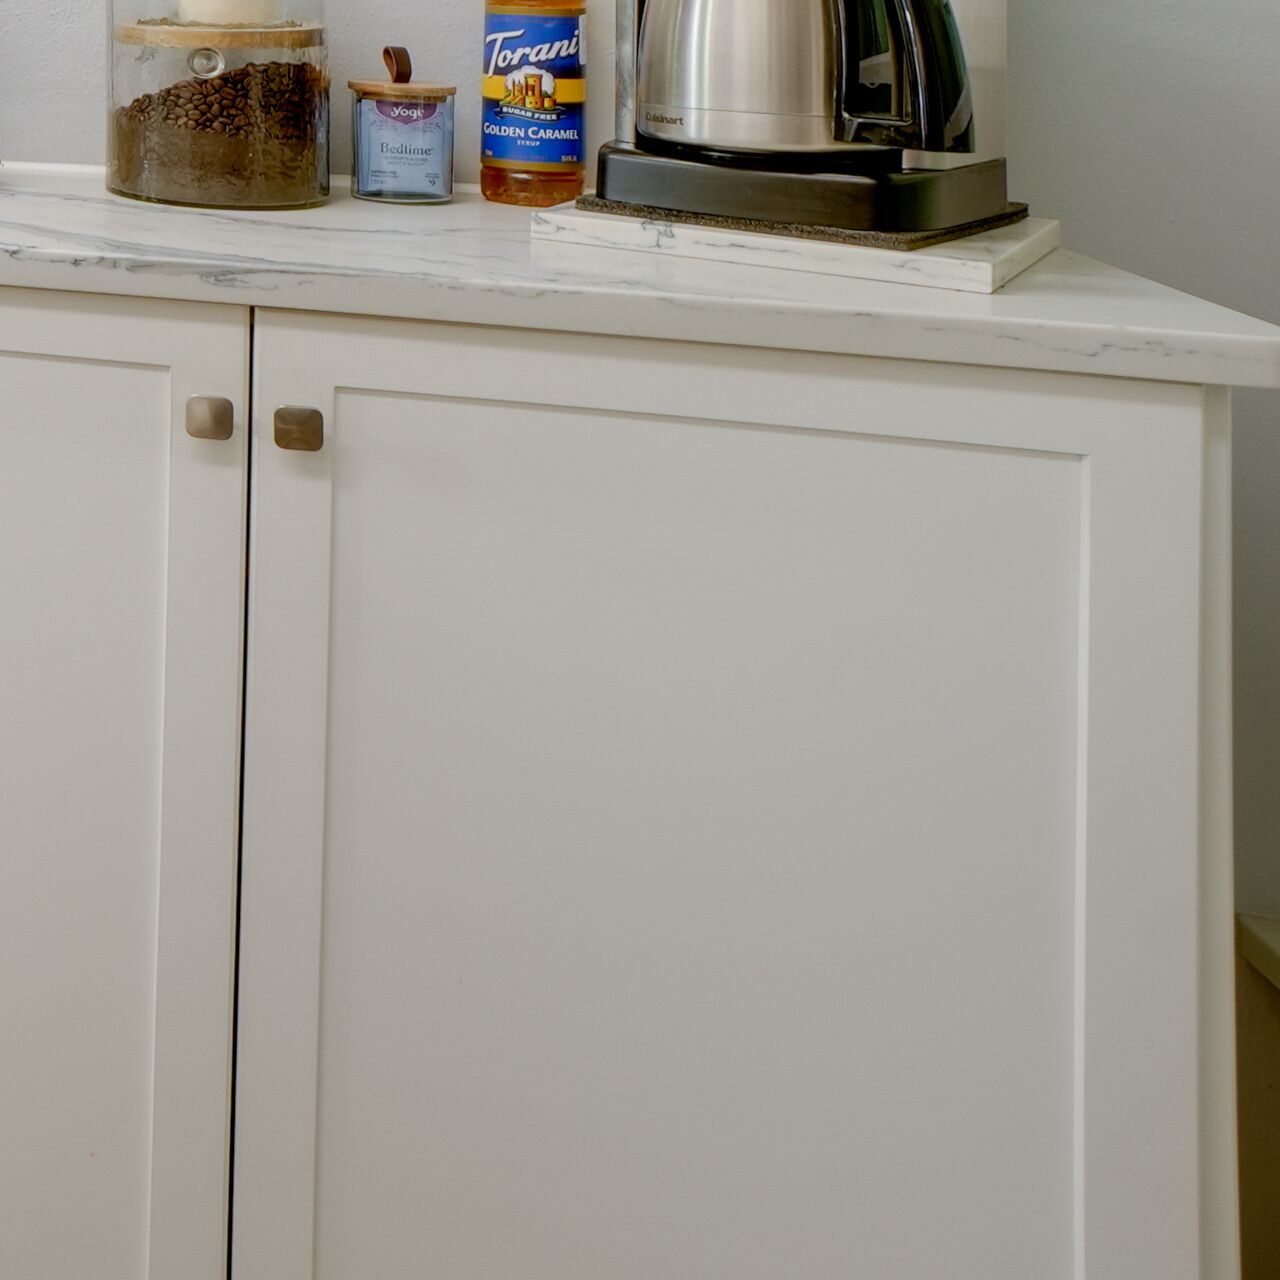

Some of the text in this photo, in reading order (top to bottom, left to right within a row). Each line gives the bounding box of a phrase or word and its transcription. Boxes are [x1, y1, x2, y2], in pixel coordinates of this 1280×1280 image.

[485, 28, 580, 78] Torani
[501, 105, 558, 121] SUGAR FREE
[483, 122, 579, 140] GOLDEN CARAMEL
[380, 142, 434, 156] Bedtime
